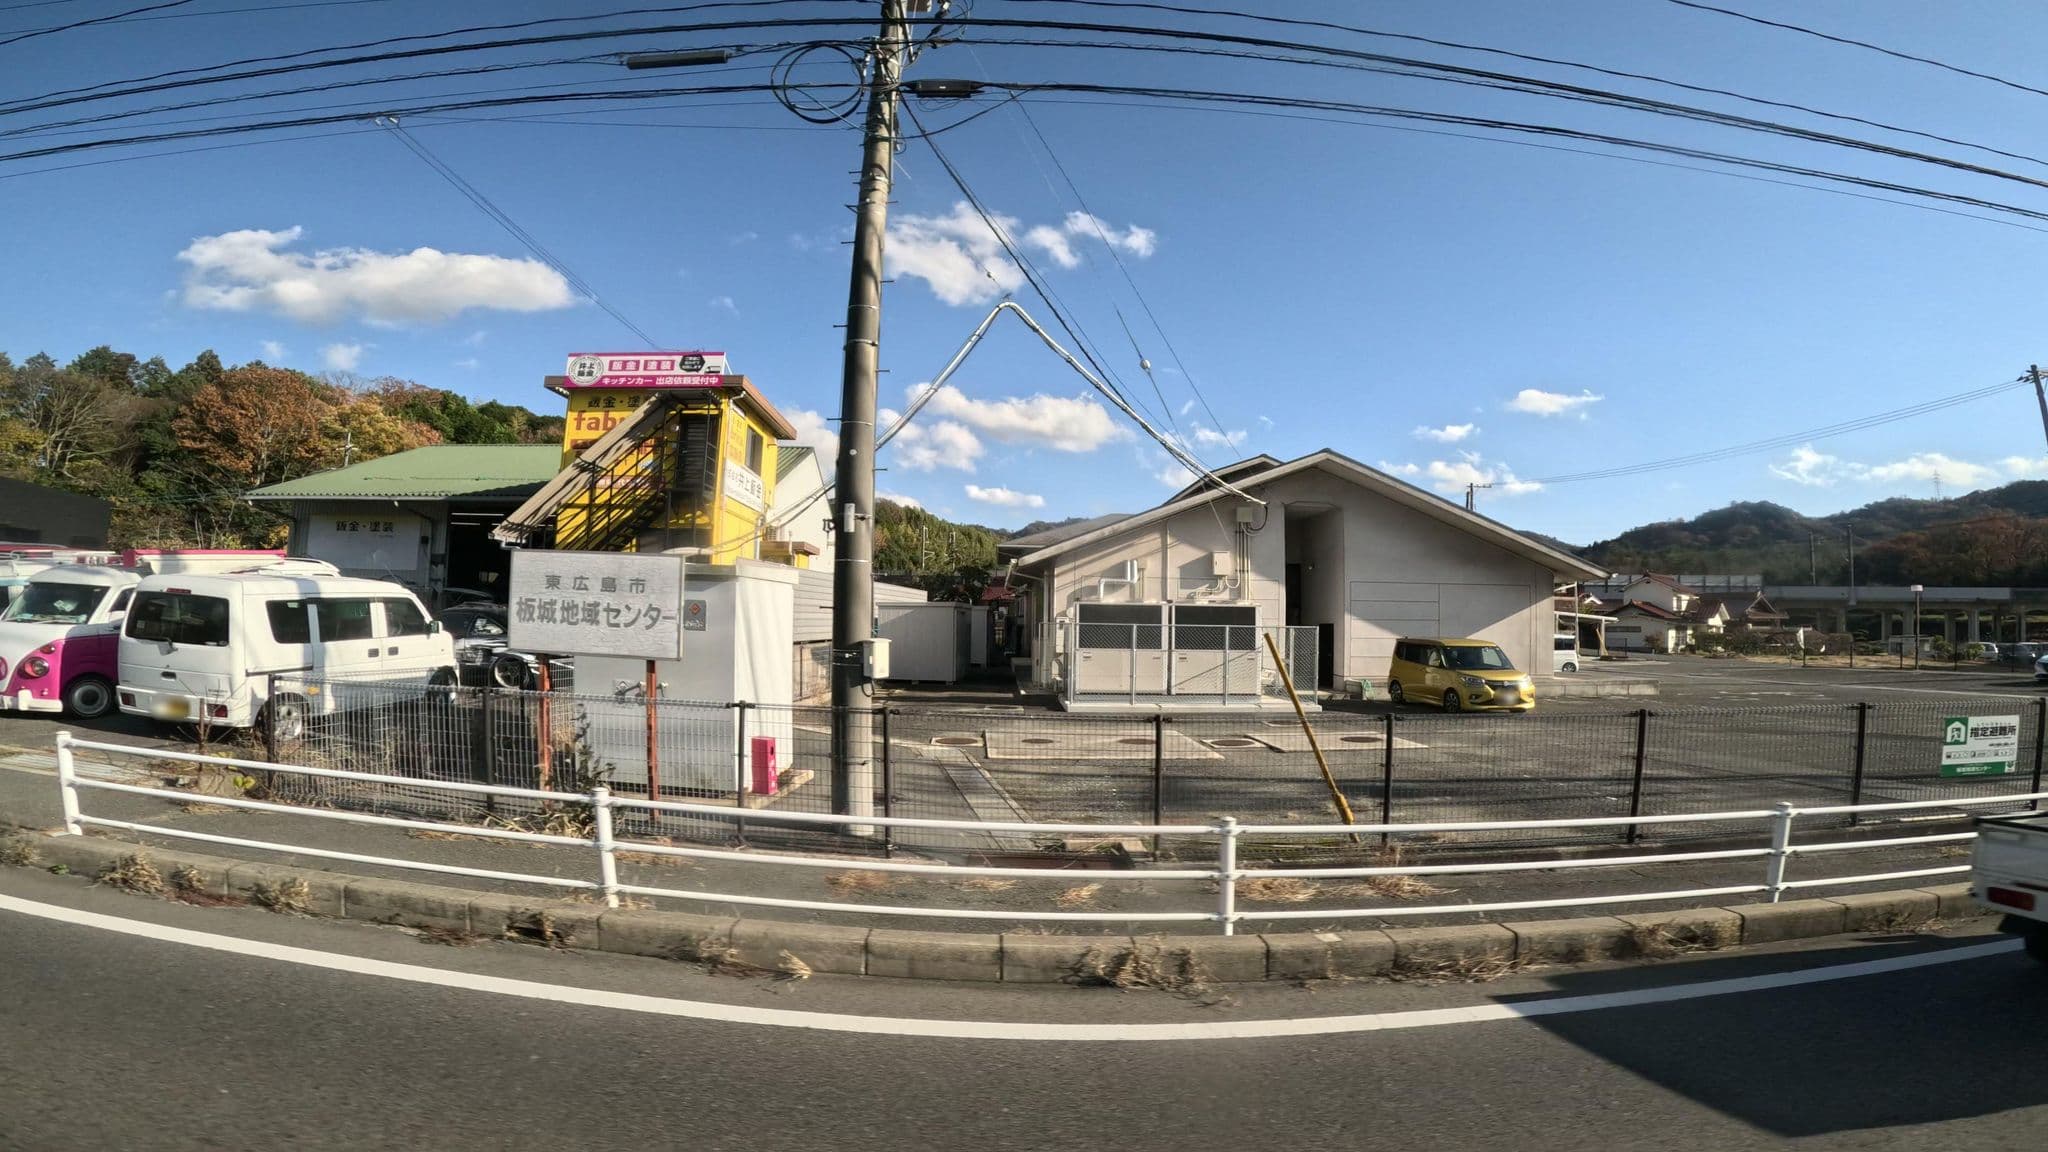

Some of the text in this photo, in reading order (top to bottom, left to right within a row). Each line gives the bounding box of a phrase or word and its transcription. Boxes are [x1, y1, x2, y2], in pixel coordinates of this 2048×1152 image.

[602, 376, 719, 385] キッチンカー 出店依頼受付中
[574, 410, 626, 432] fab
[544, 574, 647, 594] 東広島市
[515, 596, 677, 630] 板城地域センター
[1970, 726, 2016, 737] 指定避難所
